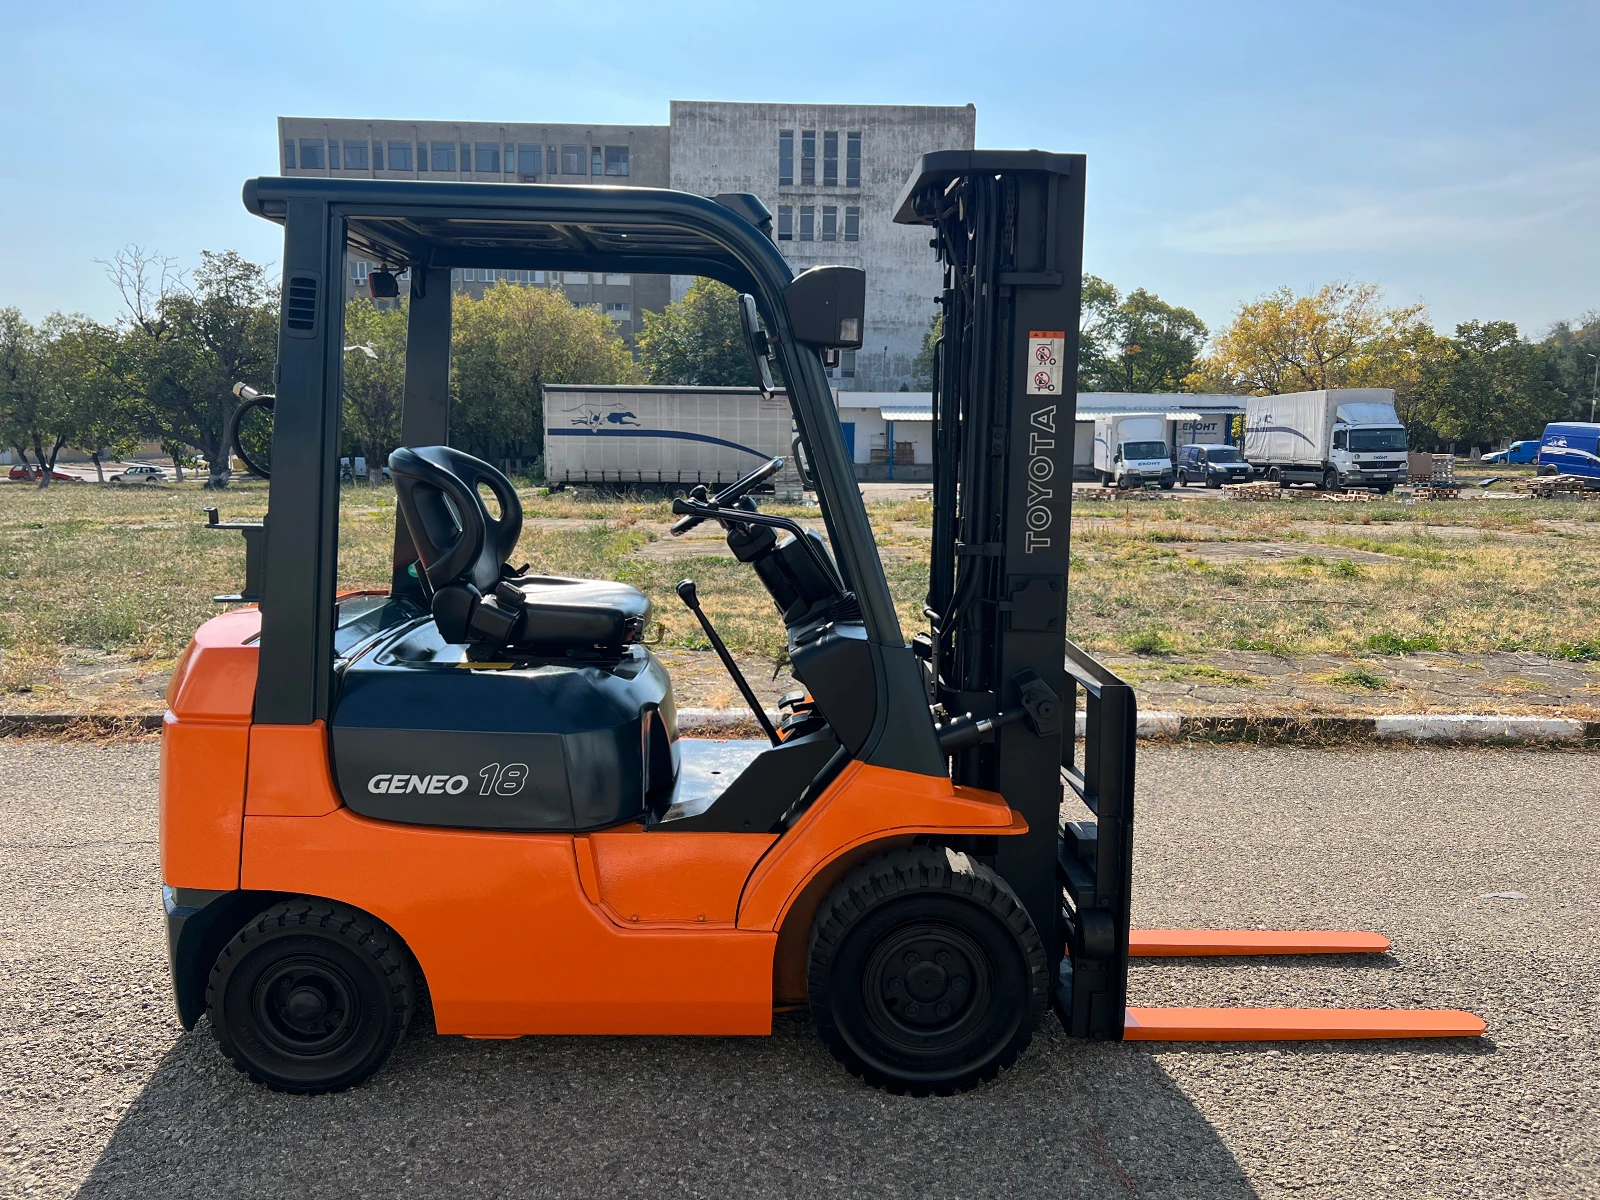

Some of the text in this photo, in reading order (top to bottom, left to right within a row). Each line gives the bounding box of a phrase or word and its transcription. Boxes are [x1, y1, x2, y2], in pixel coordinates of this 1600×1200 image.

[1025, 404, 1057, 554] TOYOTA
[367, 762, 529, 796] GENEO 18
